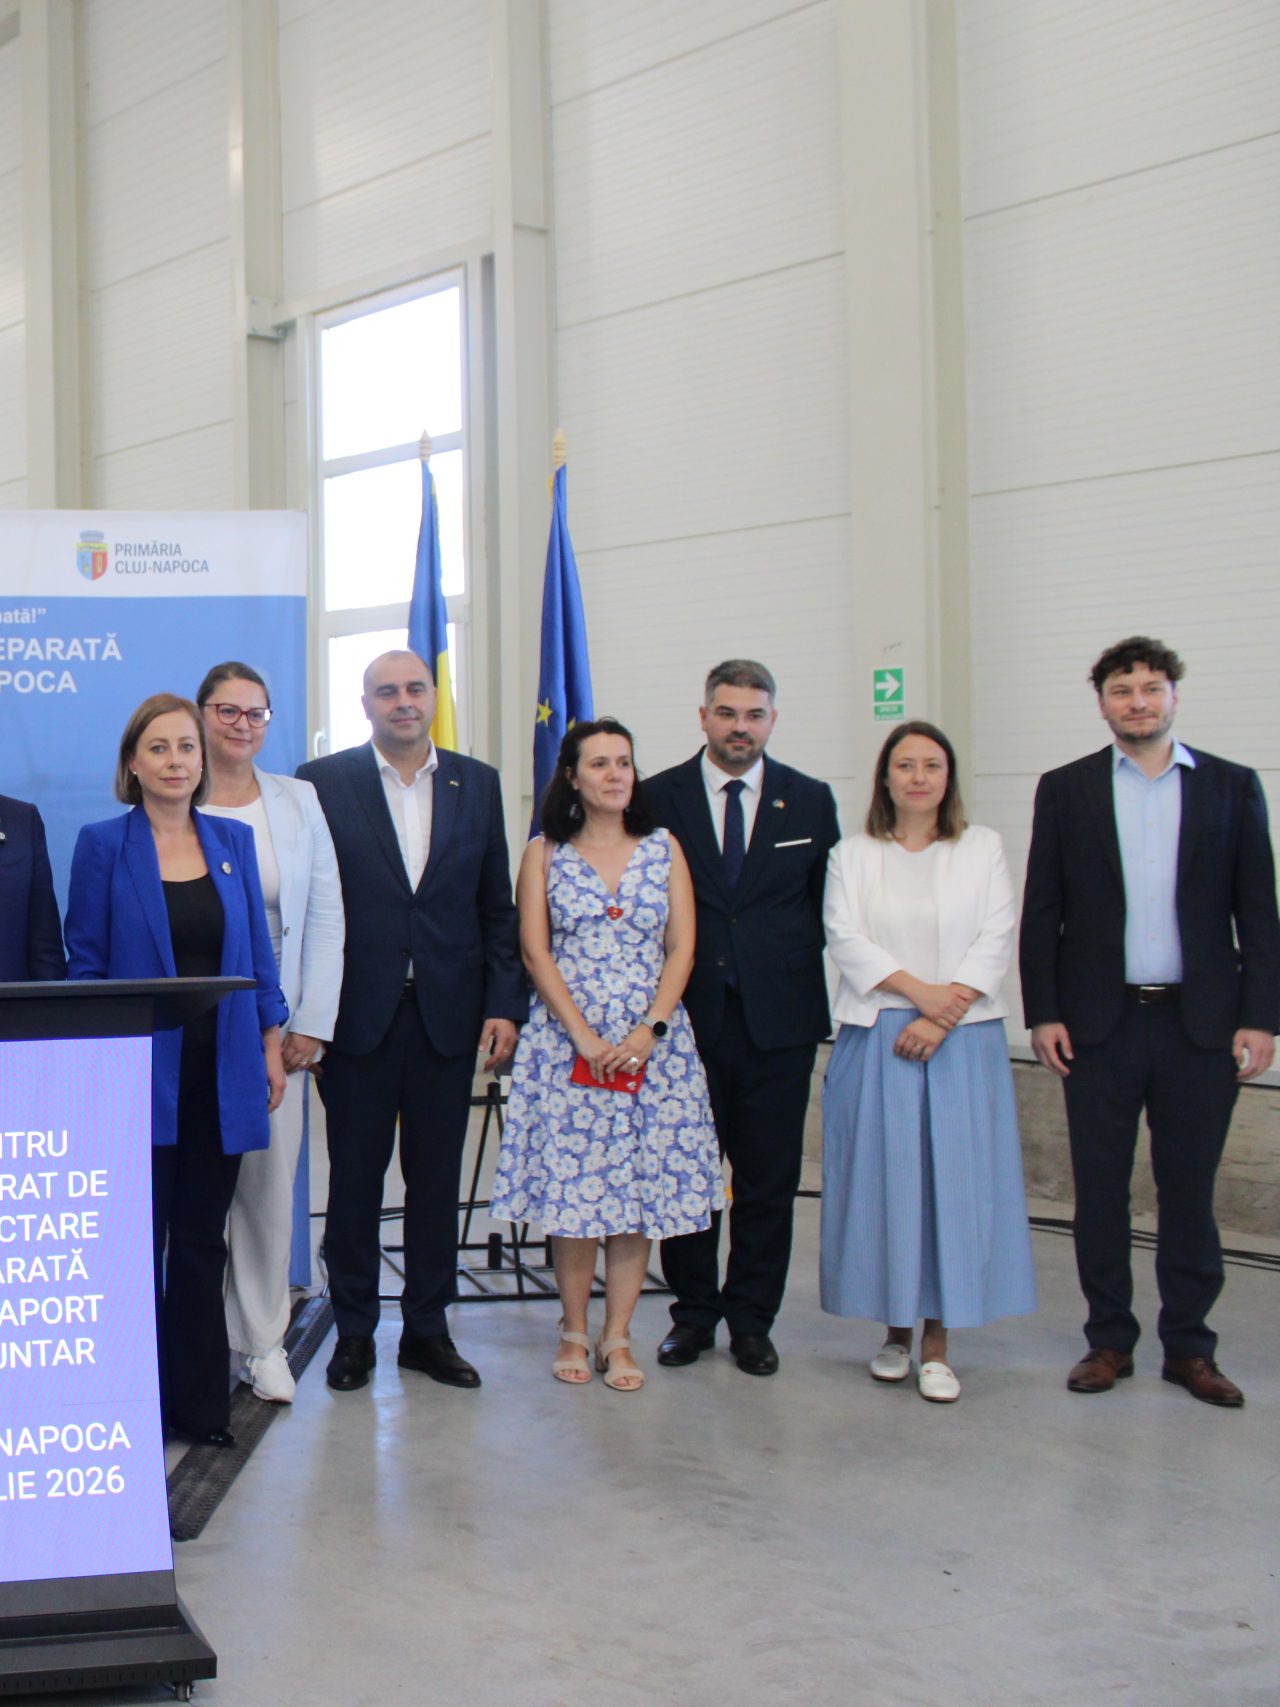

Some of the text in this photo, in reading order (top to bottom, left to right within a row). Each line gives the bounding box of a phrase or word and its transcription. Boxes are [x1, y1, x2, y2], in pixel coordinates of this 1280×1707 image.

[115, 540, 182, 557] PRIMĂRIA
[115, 560, 210, 574] CLUJ-NAPOCA
[68, 1170, 108, 1198] DE
[46, 1465, 126, 1498] 2026
